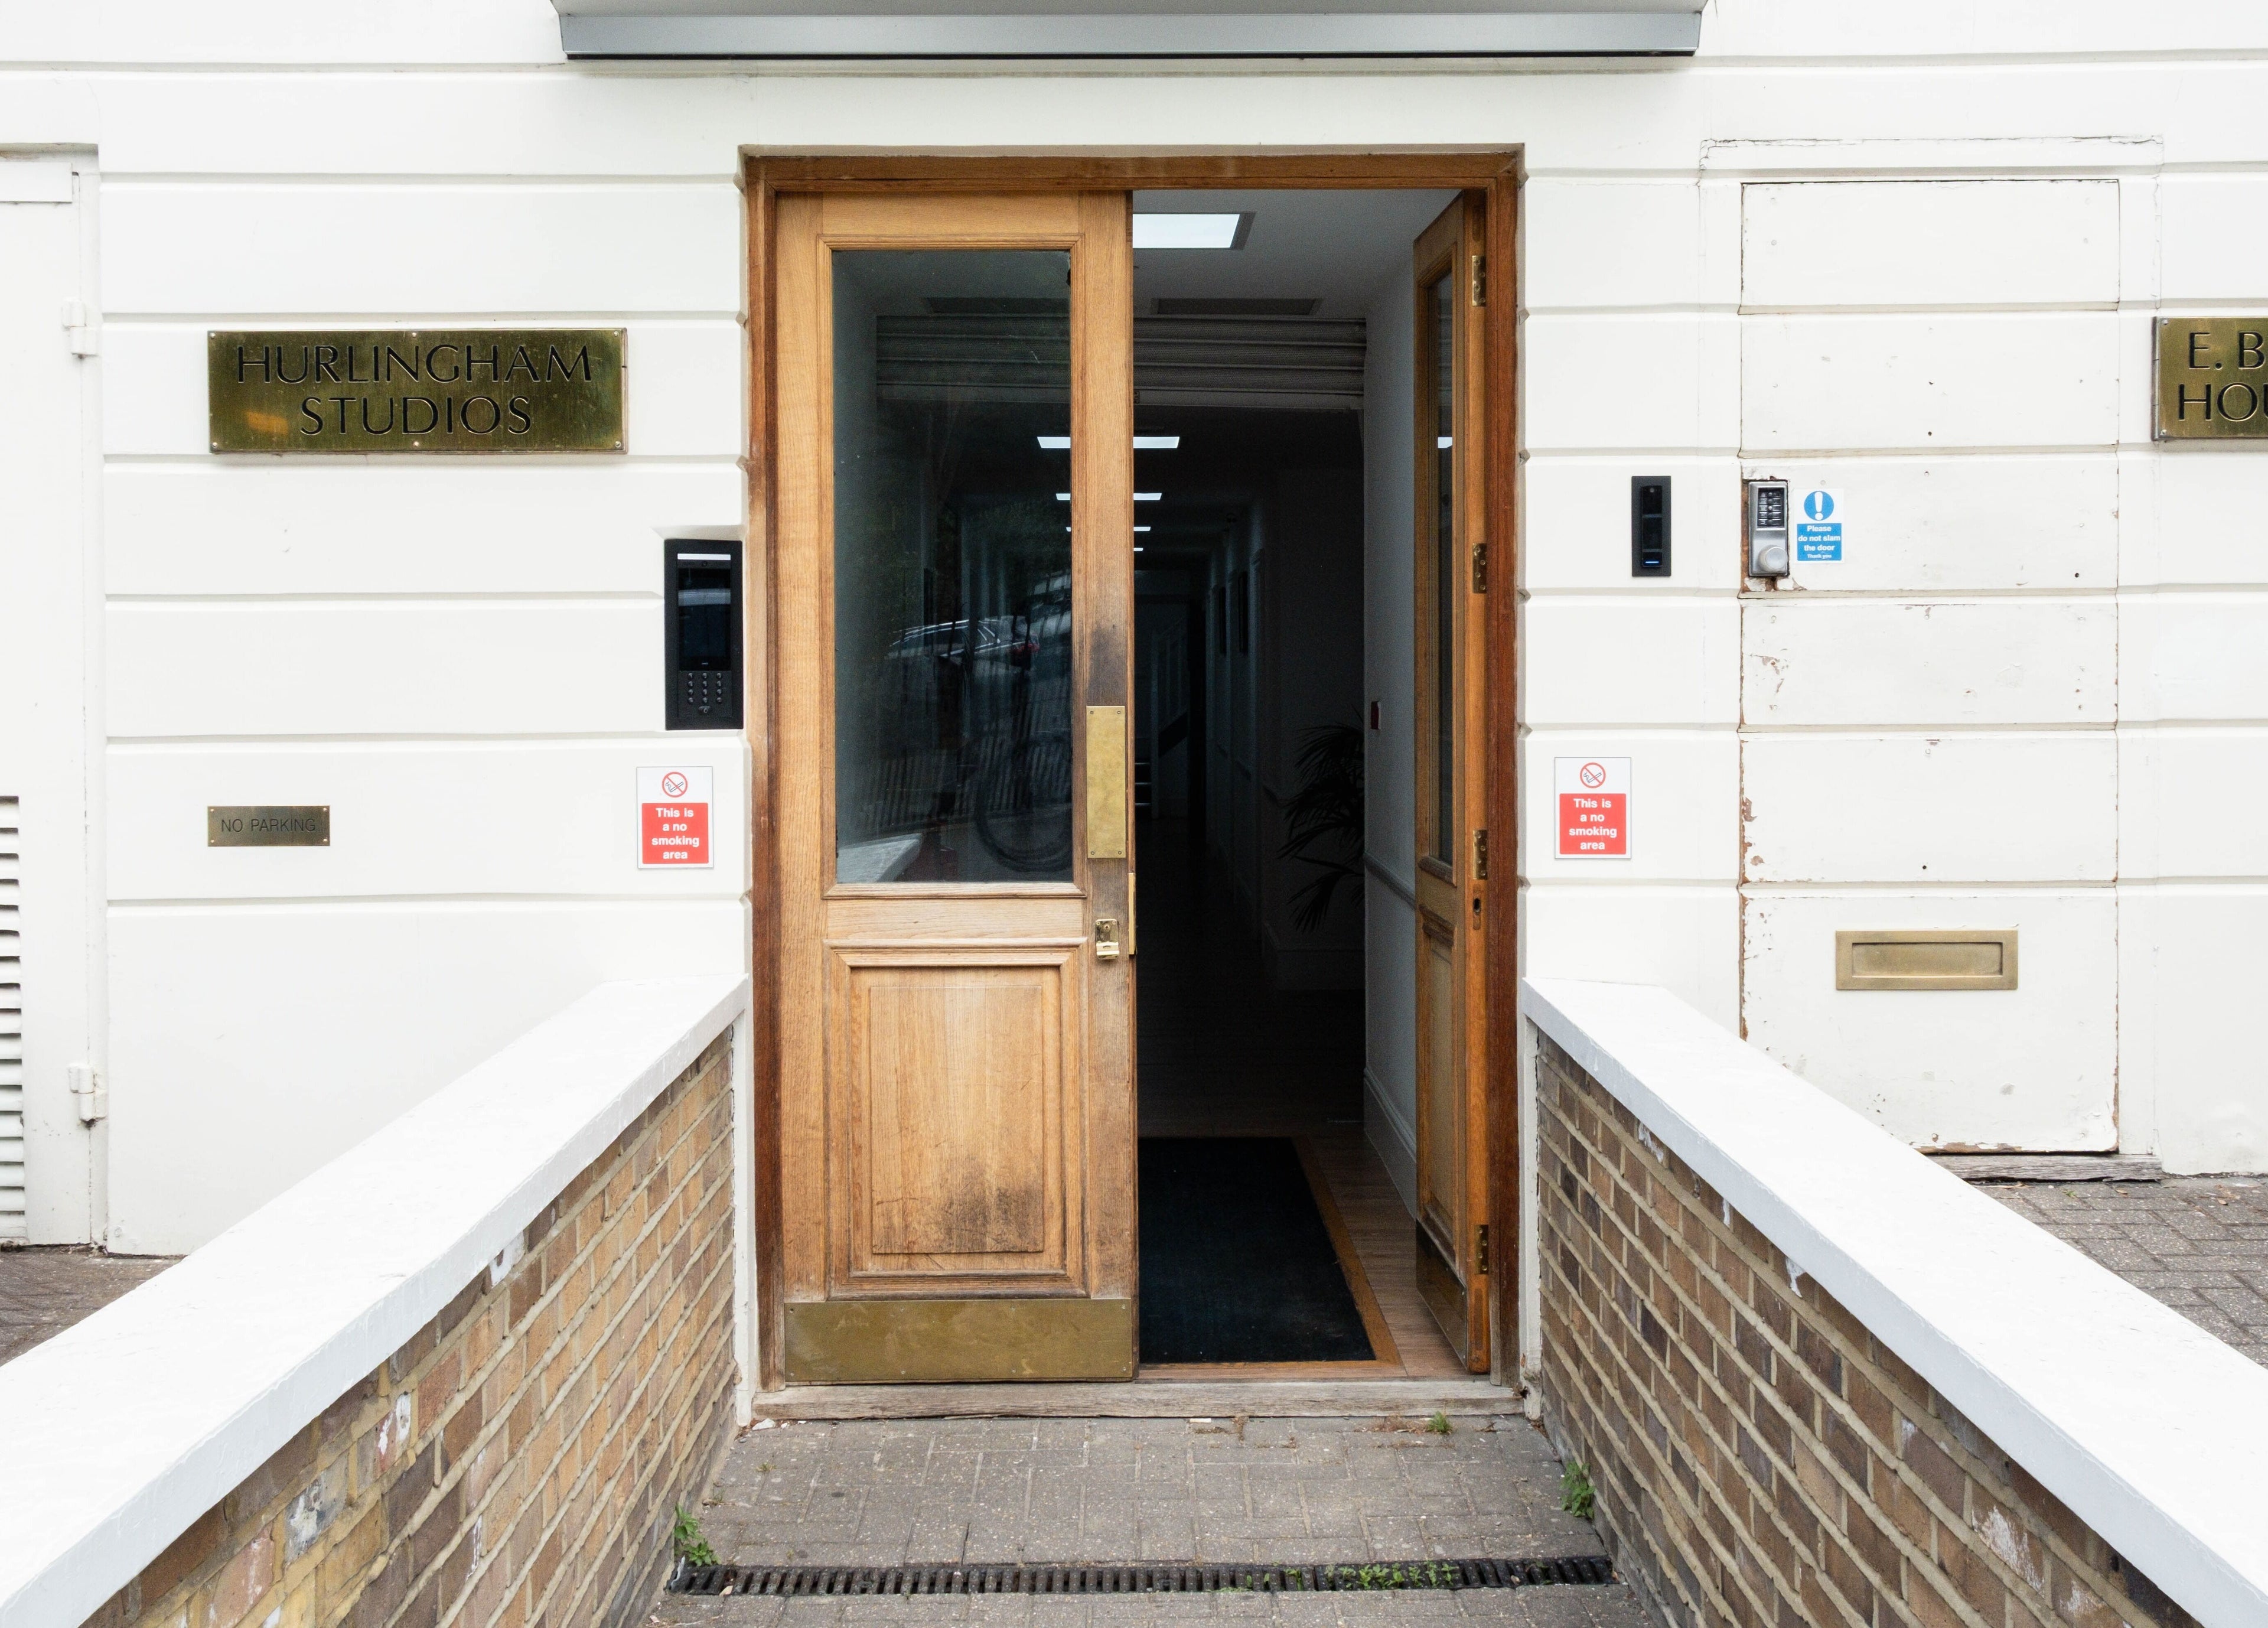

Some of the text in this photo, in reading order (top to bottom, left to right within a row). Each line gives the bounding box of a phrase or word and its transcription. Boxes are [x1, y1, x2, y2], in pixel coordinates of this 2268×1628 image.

[2188, 332, 2223, 370] E.
[237, 344, 591, 384] HURLINGHAM
[2178, 382, 2268, 422] HO
[300, 396, 532, 435] STUDIOS
[1573, 798, 1611, 808] This is
[656, 808, 694, 818] This is
[221, 818, 316, 832] NO PARKING
[1569, 826, 1617, 838] smoking
[651, 836, 699, 847] smoking
[1580, 842, 1605, 850] area
[663, 851, 688, 859] area
